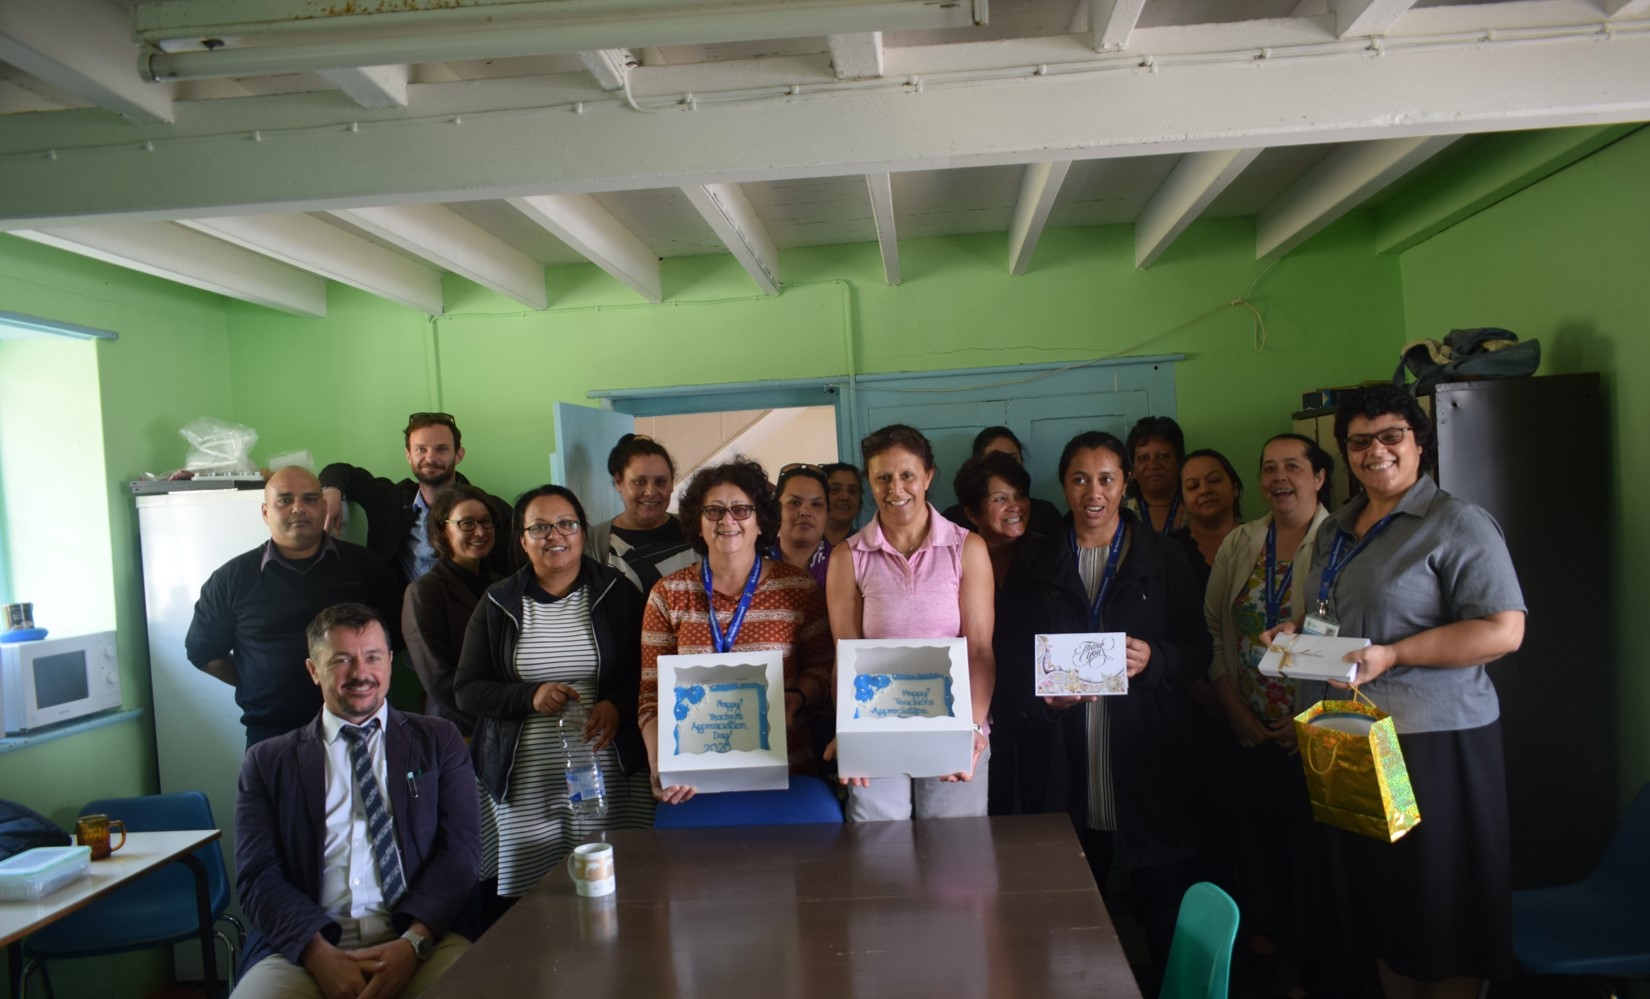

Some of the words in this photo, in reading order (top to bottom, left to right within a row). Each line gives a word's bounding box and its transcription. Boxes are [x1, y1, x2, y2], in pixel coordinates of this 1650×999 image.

[902, 687, 930, 702] Happy
[716, 698, 744, 715] Happy
[713, 730, 733, 746] Day
